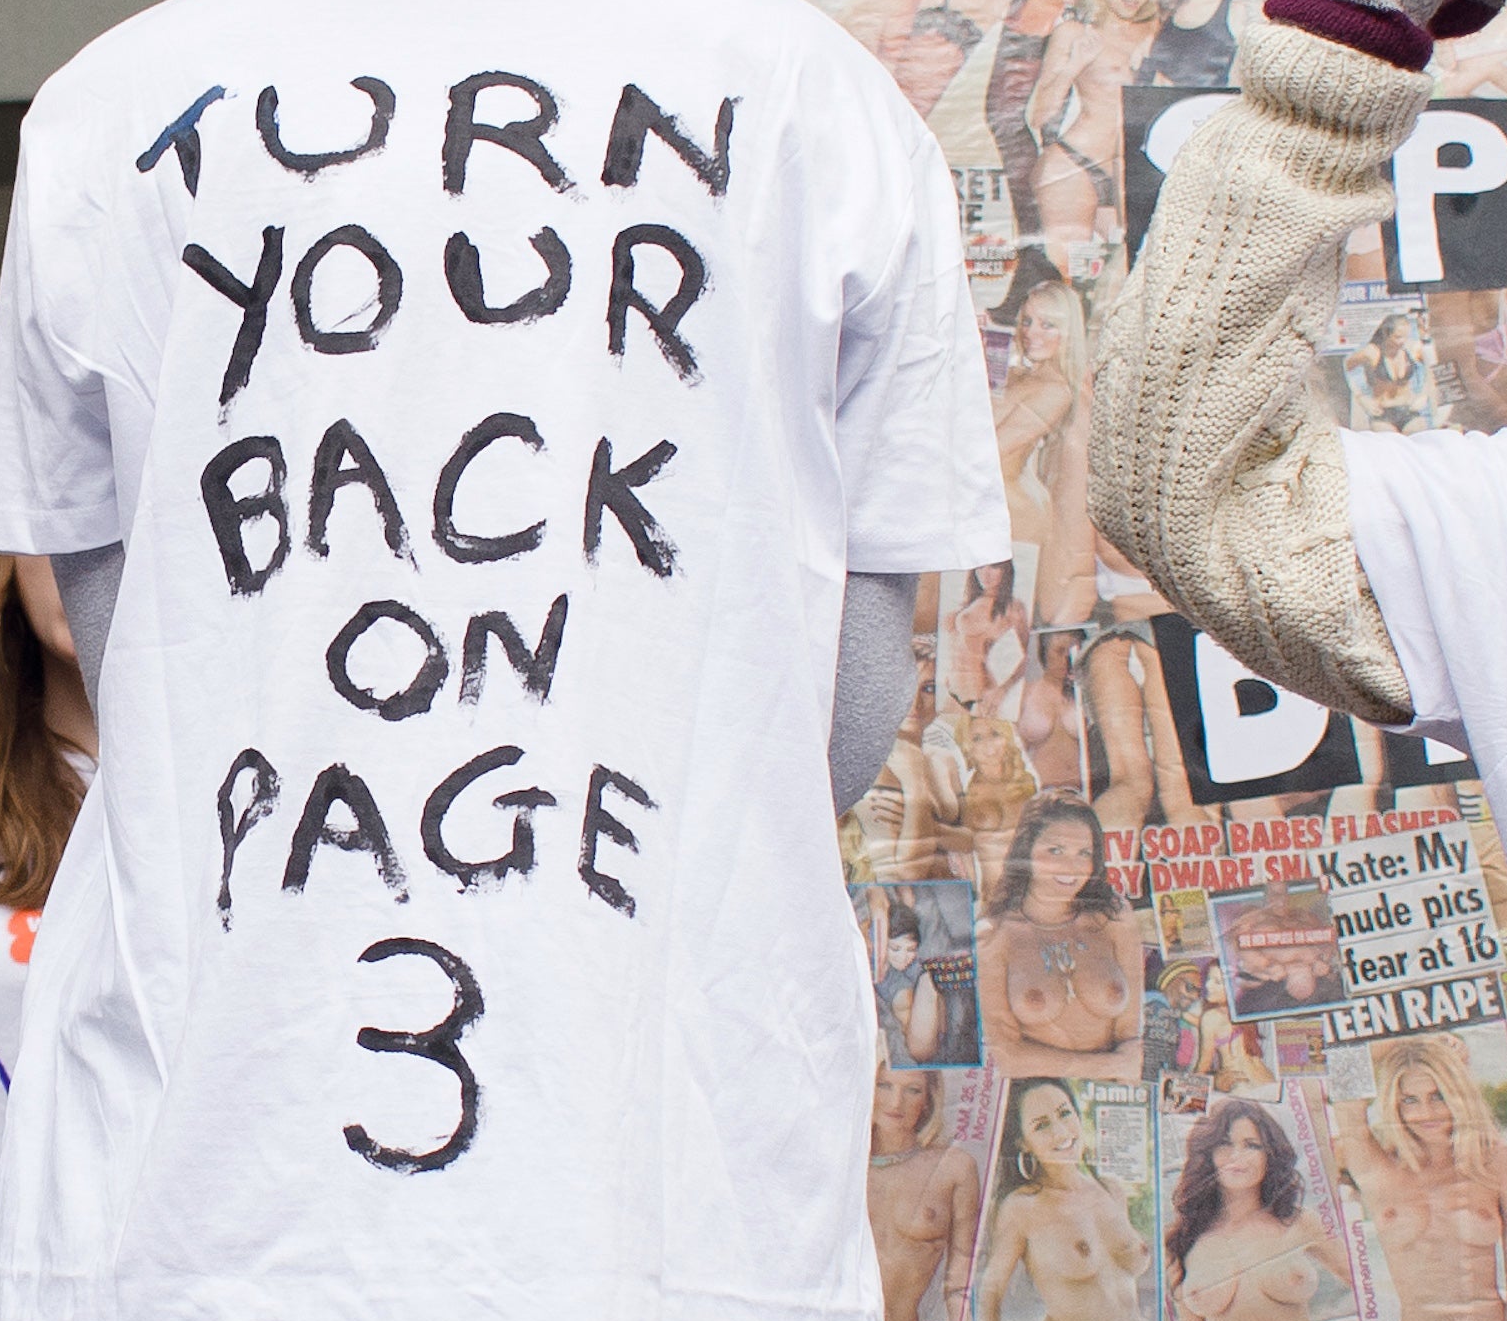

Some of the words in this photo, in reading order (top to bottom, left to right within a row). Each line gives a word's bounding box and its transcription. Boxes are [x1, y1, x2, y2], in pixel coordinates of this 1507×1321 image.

[134, 70, 741, 201] TURN
[181, 223, 709, 426] YOUR
[200, 410, 683, 598] BACK
[326, 592, 570, 722] ON
[216, 745, 659, 932] PAGE
[1142, 823, 1222, 861] SOAP
[1228, 816, 1324, 855] BABES
[1319, 852, 1410, 892] Kate:
[1415, 830, 1469, 875] My
[1334, 899, 1412, 939] nude
[1423, 884, 1484, 926] pics
[1343, 947, 1410, 987] fear
[1418, 936, 1452, 970] at
[1457, 922, 1499, 964] 16
[343, 935, 484, 1173] 3
[1401, 977, 1502, 1032] RAPE
